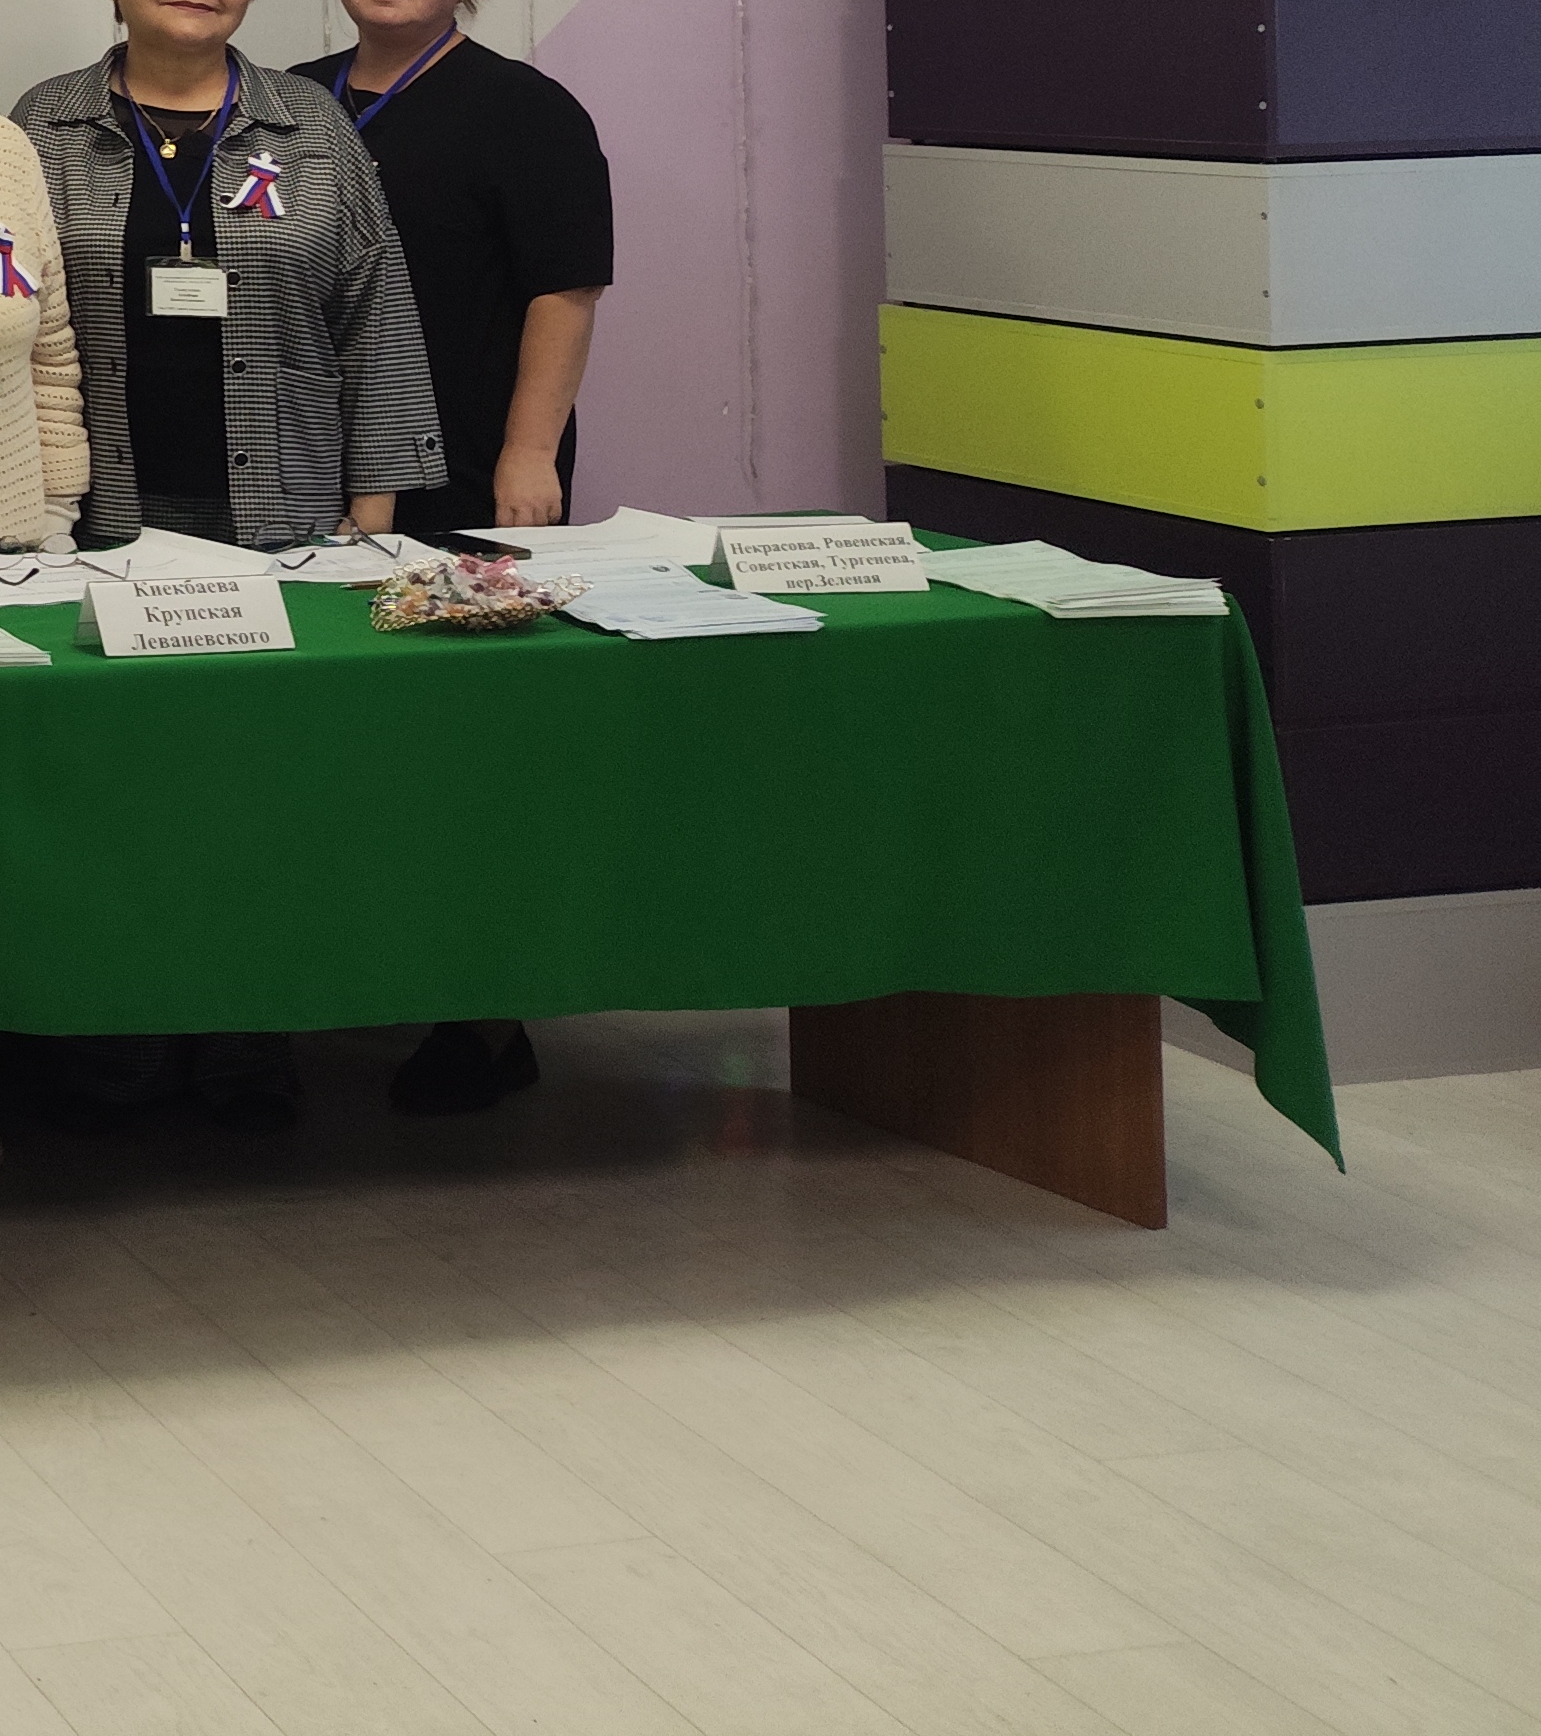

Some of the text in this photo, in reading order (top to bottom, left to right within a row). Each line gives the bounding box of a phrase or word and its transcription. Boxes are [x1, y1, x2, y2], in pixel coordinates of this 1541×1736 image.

[735, 553, 915, 574] Советская, Тургенева,
[133, 579, 240, 598] Киекбаева
[786, 574, 882, 591] пер.Зеленая
[143, 606, 243, 627] Крупская
[131, 631, 270, 651] Леваневского
